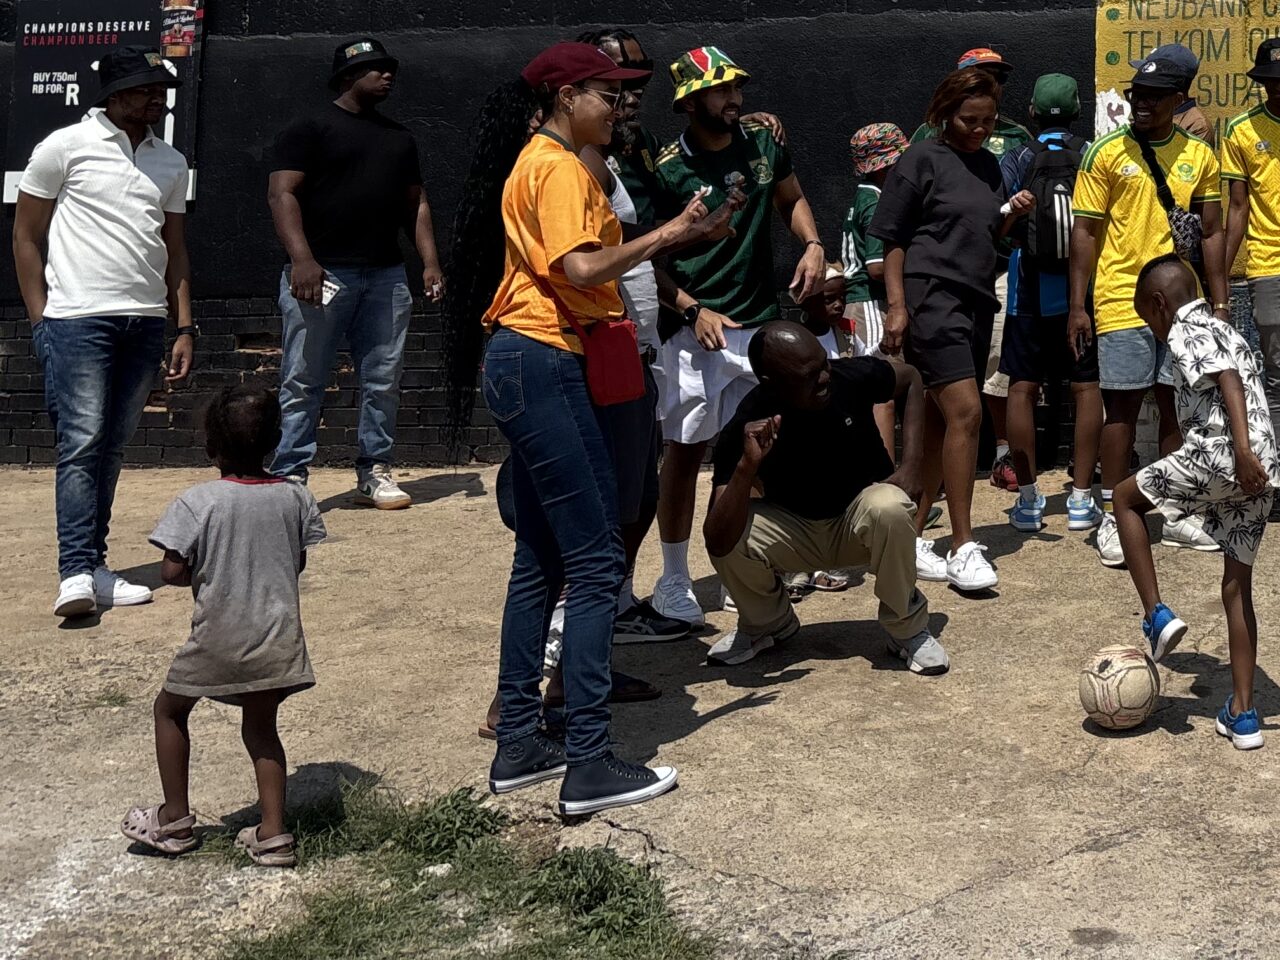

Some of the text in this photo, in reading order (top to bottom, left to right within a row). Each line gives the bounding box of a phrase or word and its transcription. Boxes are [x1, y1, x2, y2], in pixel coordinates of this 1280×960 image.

[24, 20, 151, 34] CHAMPIONS DESERVE
[23, 34, 118, 46] CHAMPION BEER
[33, 72, 77, 82] BUY 750ml
[32, 84, 64, 94] RB FOR:
[65, 83, 80, 106] R
